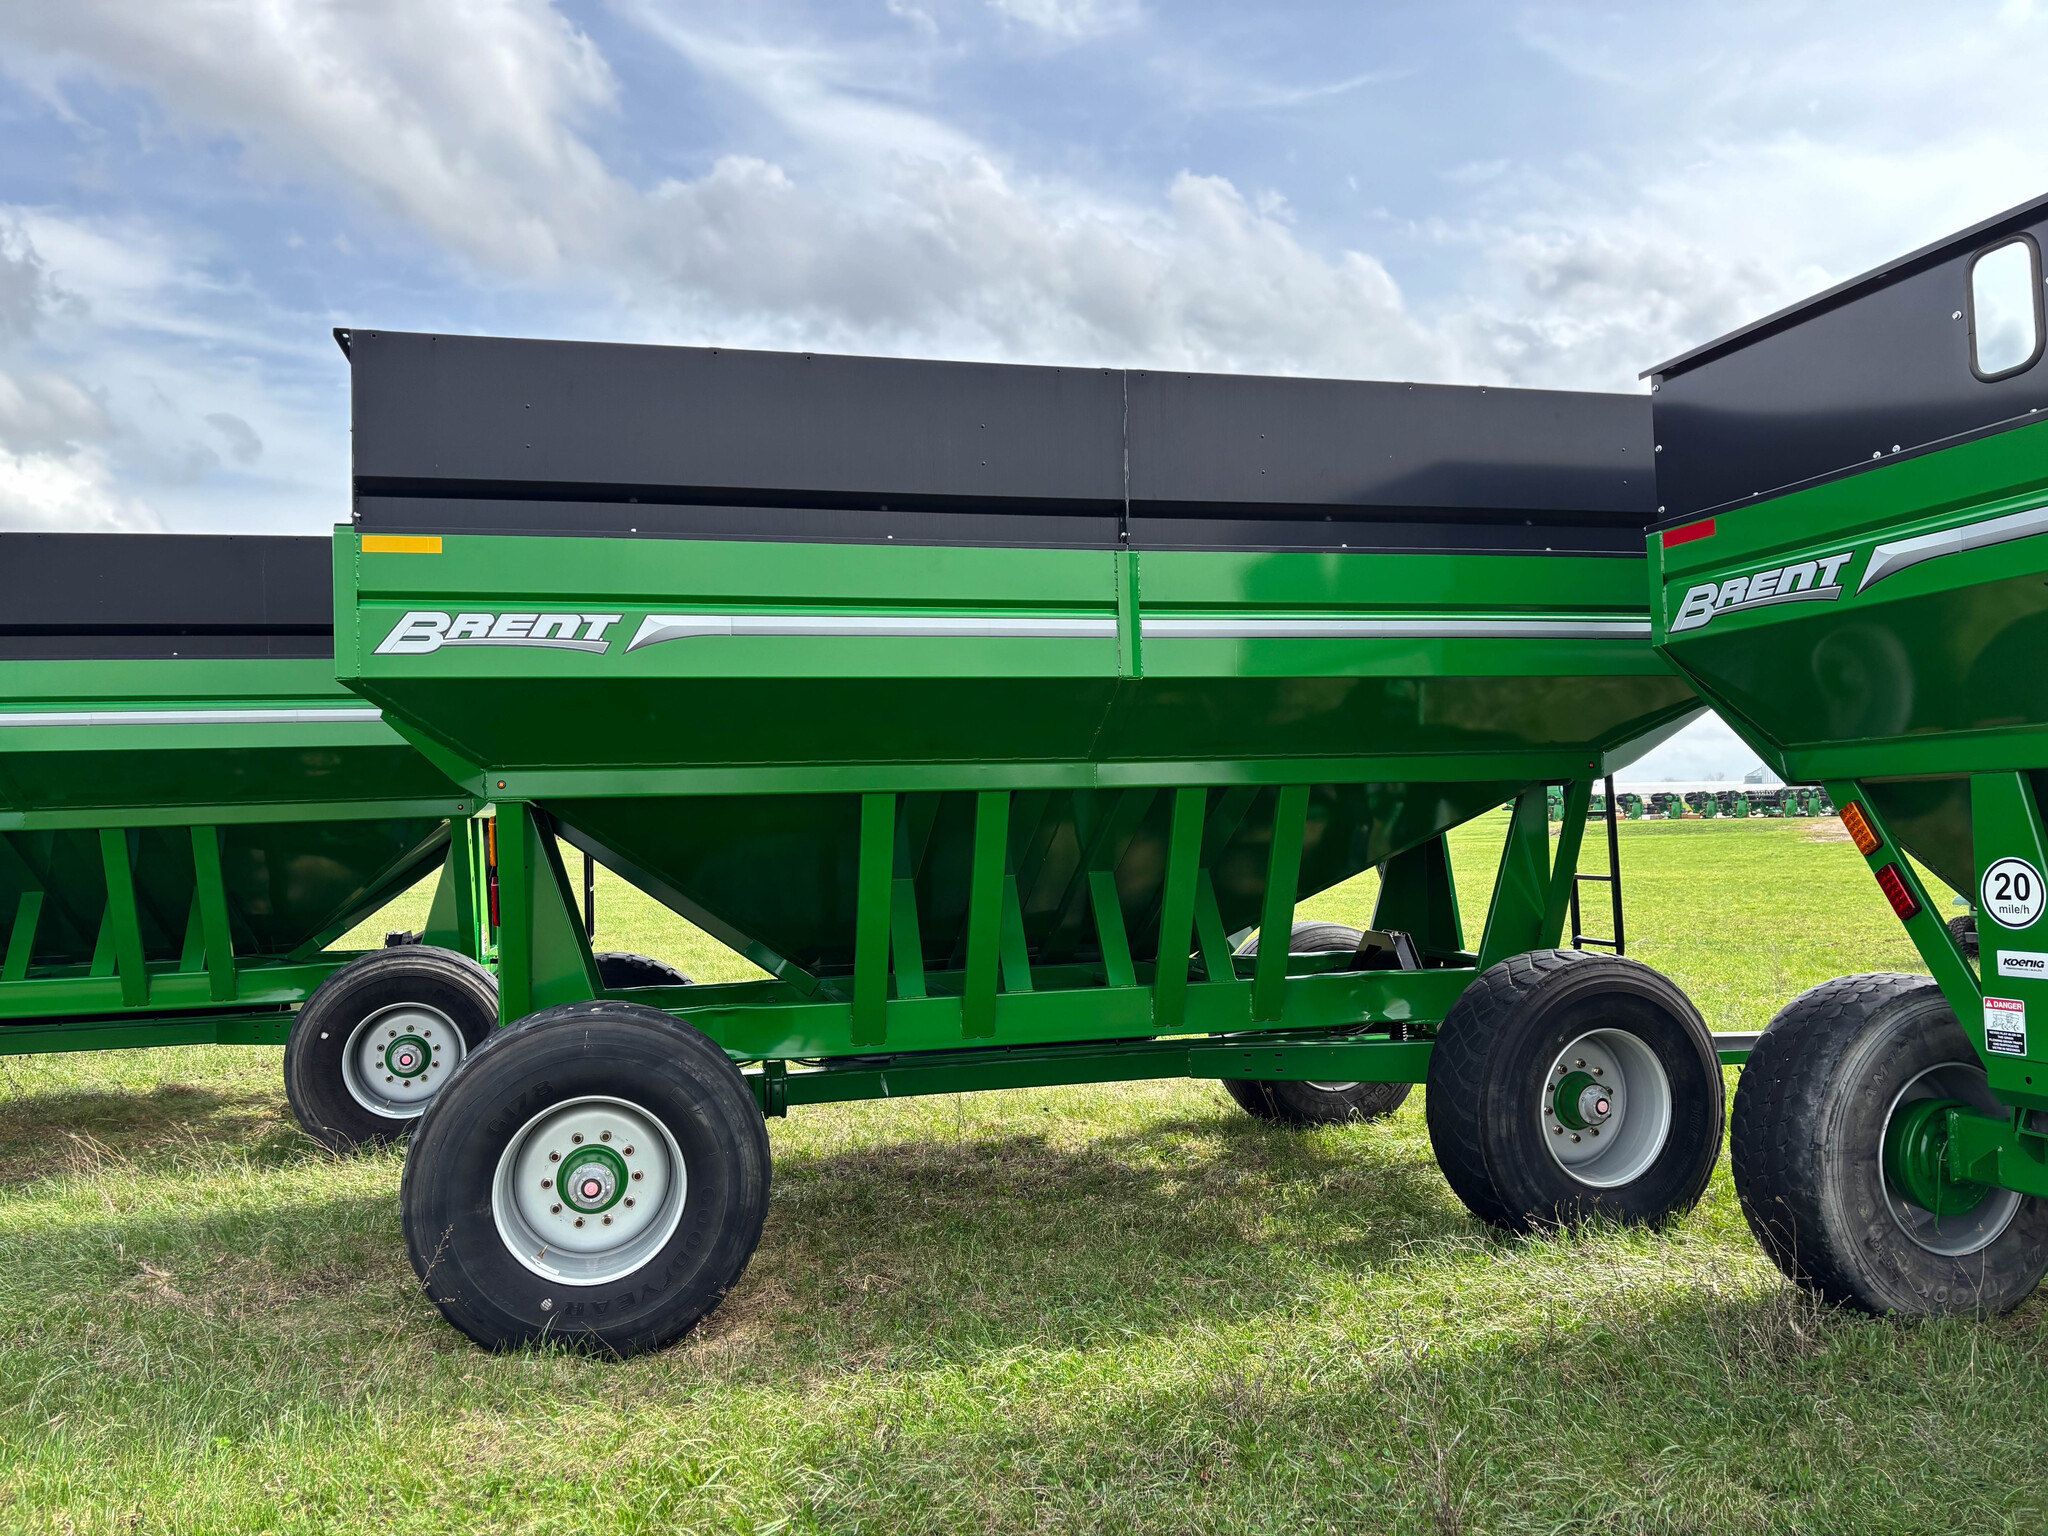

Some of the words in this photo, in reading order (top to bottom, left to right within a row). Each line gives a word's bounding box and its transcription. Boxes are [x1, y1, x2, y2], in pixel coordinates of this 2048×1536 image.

[1669, 551, 1856, 633] BRENT
[371, 610, 625, 655] BRENT
[1994, 872, 2031, 901] 20
[1999, 904, 2030, 914] mile/h
[1993, 1001, 2022, 1010] DANGER
